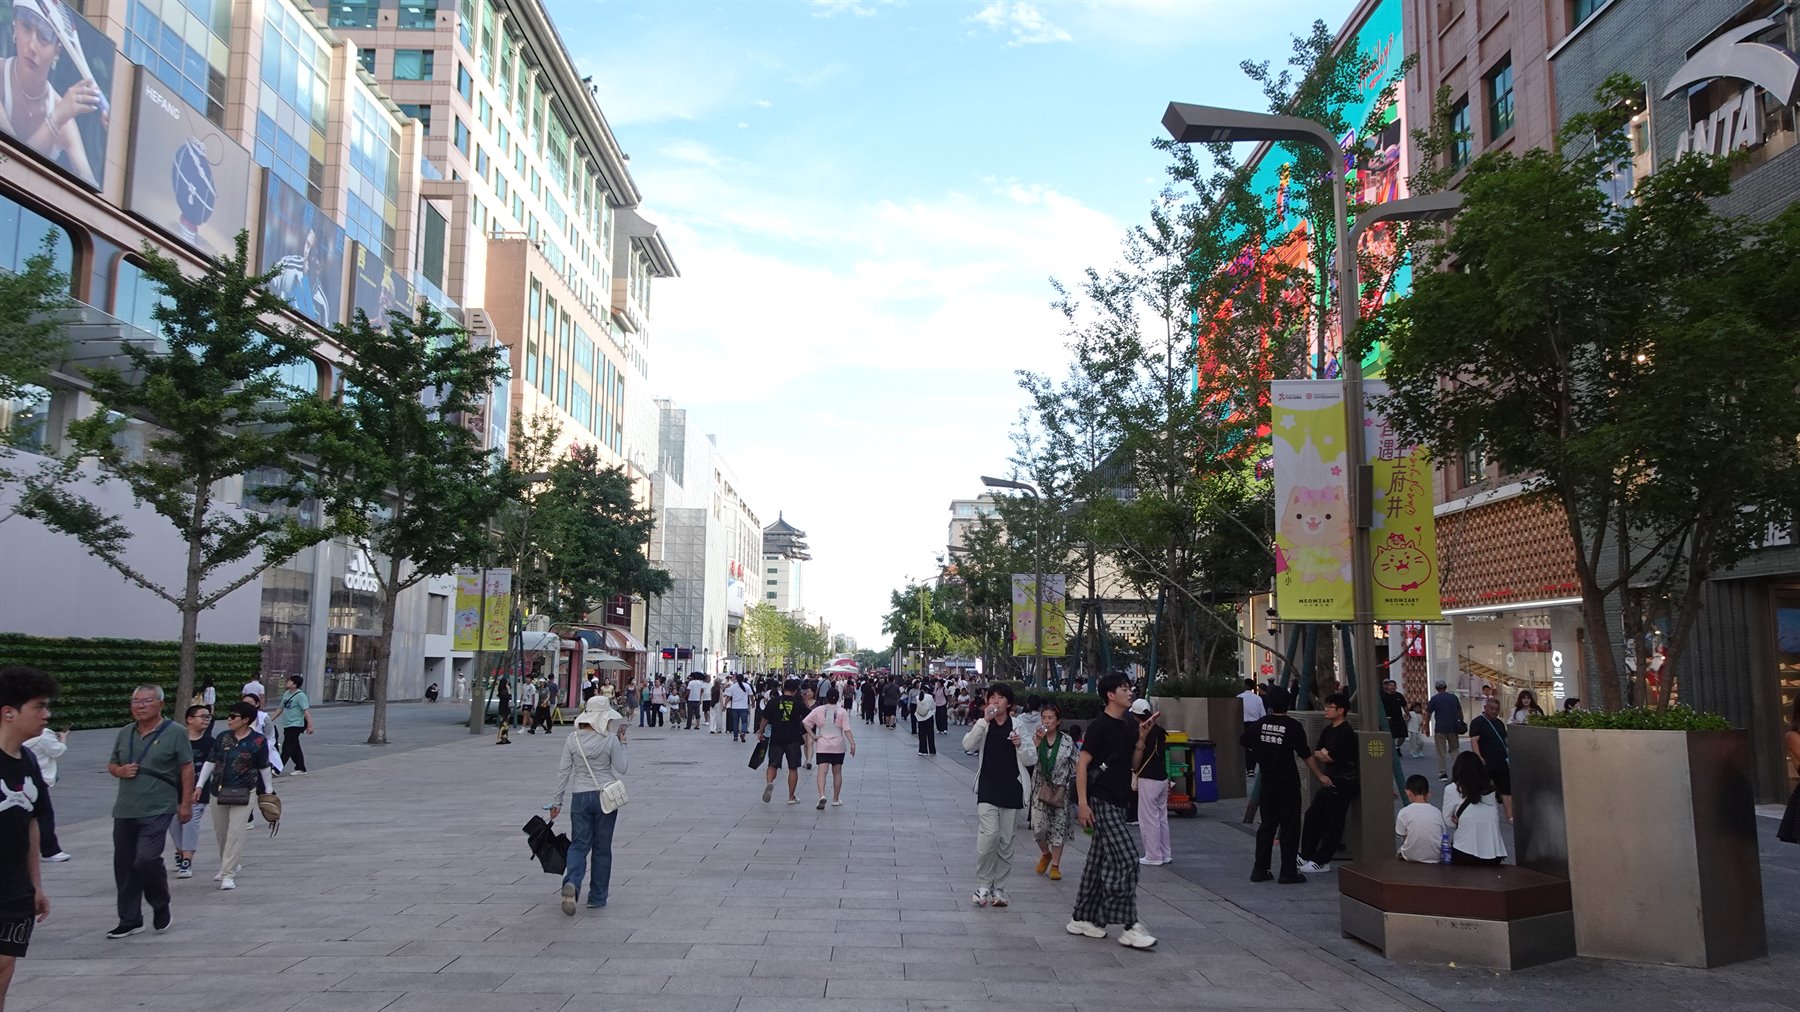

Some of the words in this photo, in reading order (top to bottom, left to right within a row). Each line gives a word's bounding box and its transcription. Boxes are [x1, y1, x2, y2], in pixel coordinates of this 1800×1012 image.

[145, 84, 181, 120] HEFANG
[1673, 85, 1764, 168] ANTA
[1384, 444, 1407, 519] 王府井
[345, 572, 379, 593] adidas
